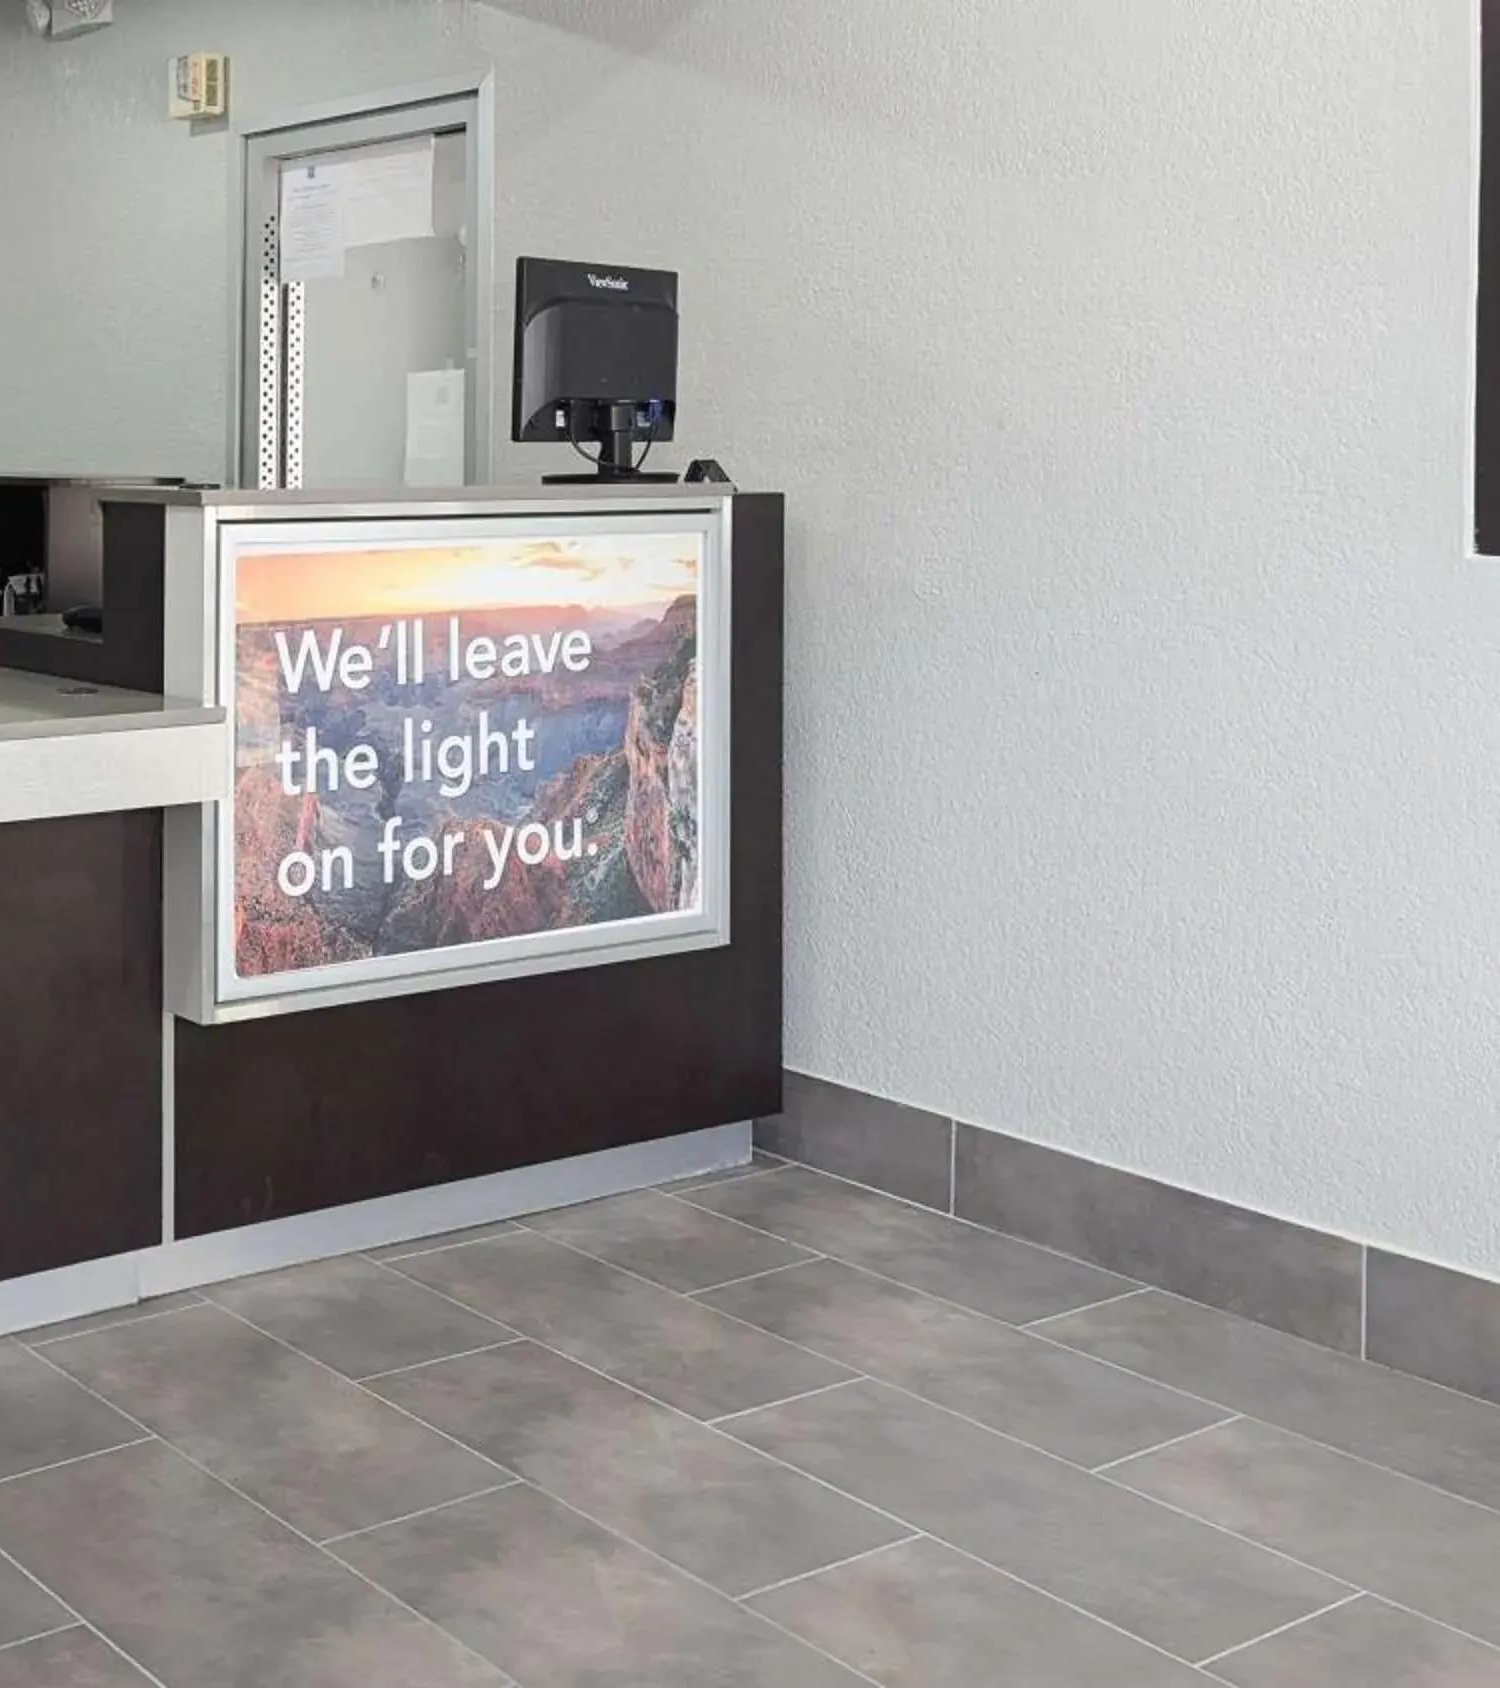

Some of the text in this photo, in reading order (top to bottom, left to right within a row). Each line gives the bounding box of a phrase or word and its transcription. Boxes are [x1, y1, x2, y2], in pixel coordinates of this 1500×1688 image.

[275, 616, 592, 694] We'll leave
[275, 710, 536, 798] the light
[277, 816, 599, 897] on for you.
